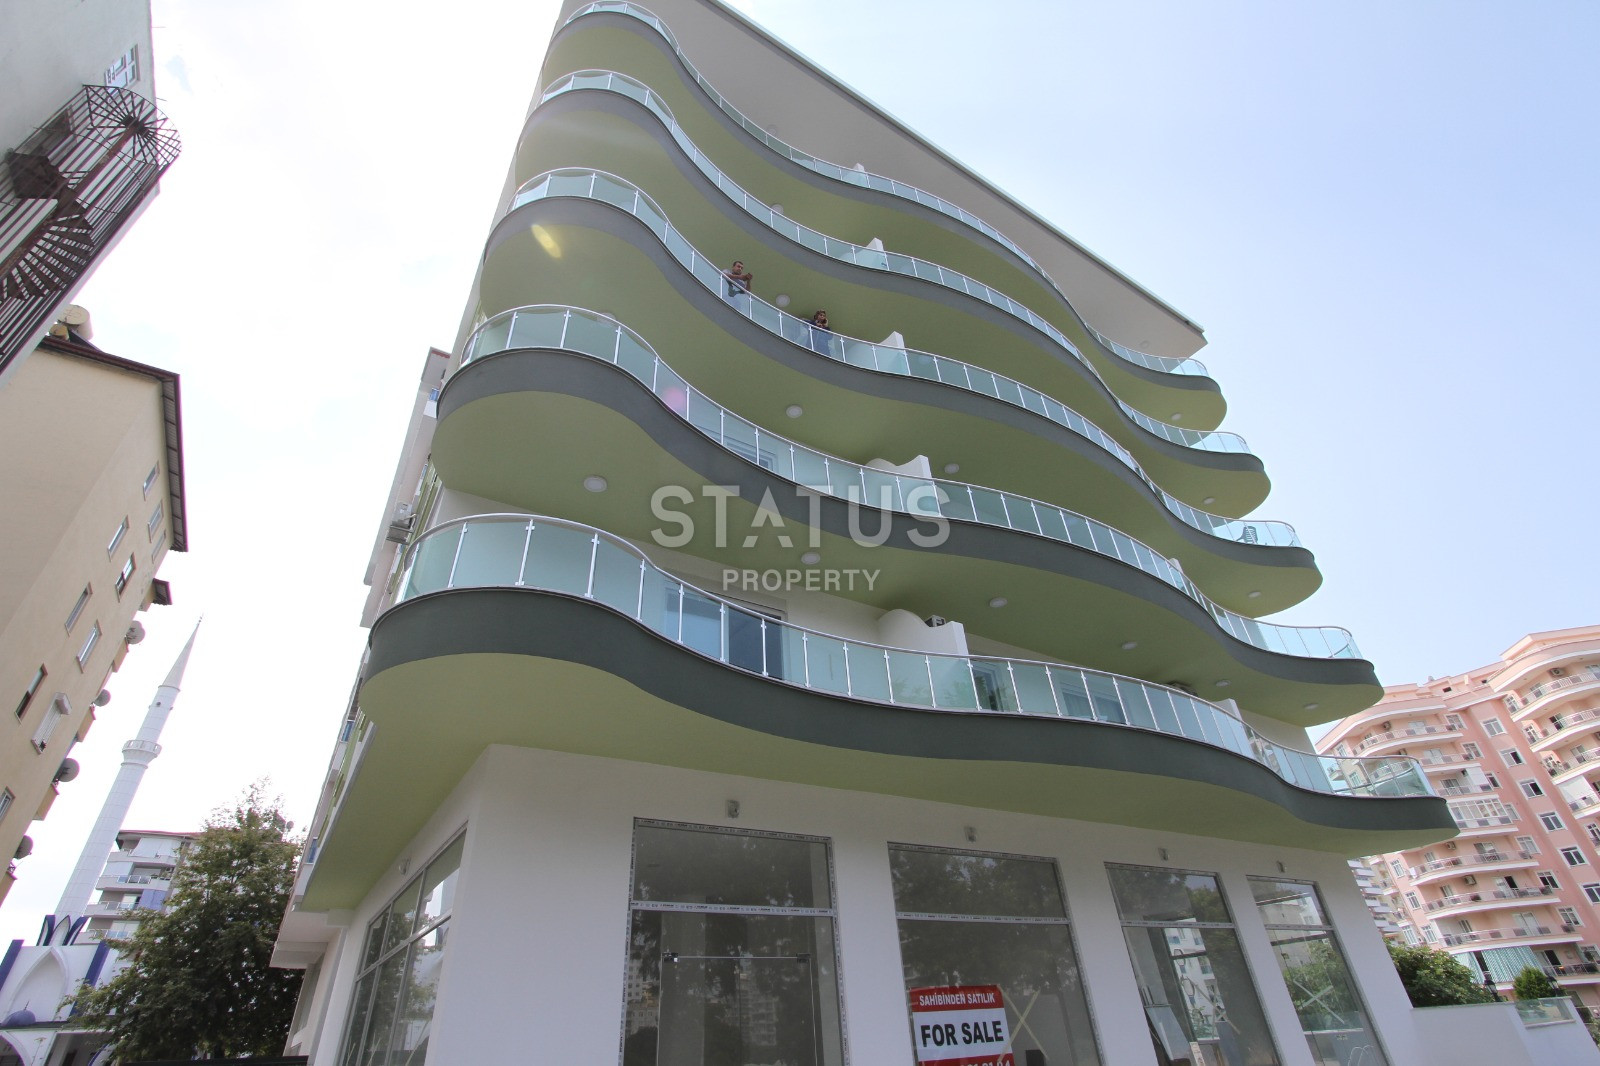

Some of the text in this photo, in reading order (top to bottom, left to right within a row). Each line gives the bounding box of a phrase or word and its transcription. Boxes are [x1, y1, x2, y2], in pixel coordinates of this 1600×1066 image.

[919, 992, 995, 1006] SAHİBİNDEN SATILIK
[920, 1020, 1004, 1048] FOR SALE
